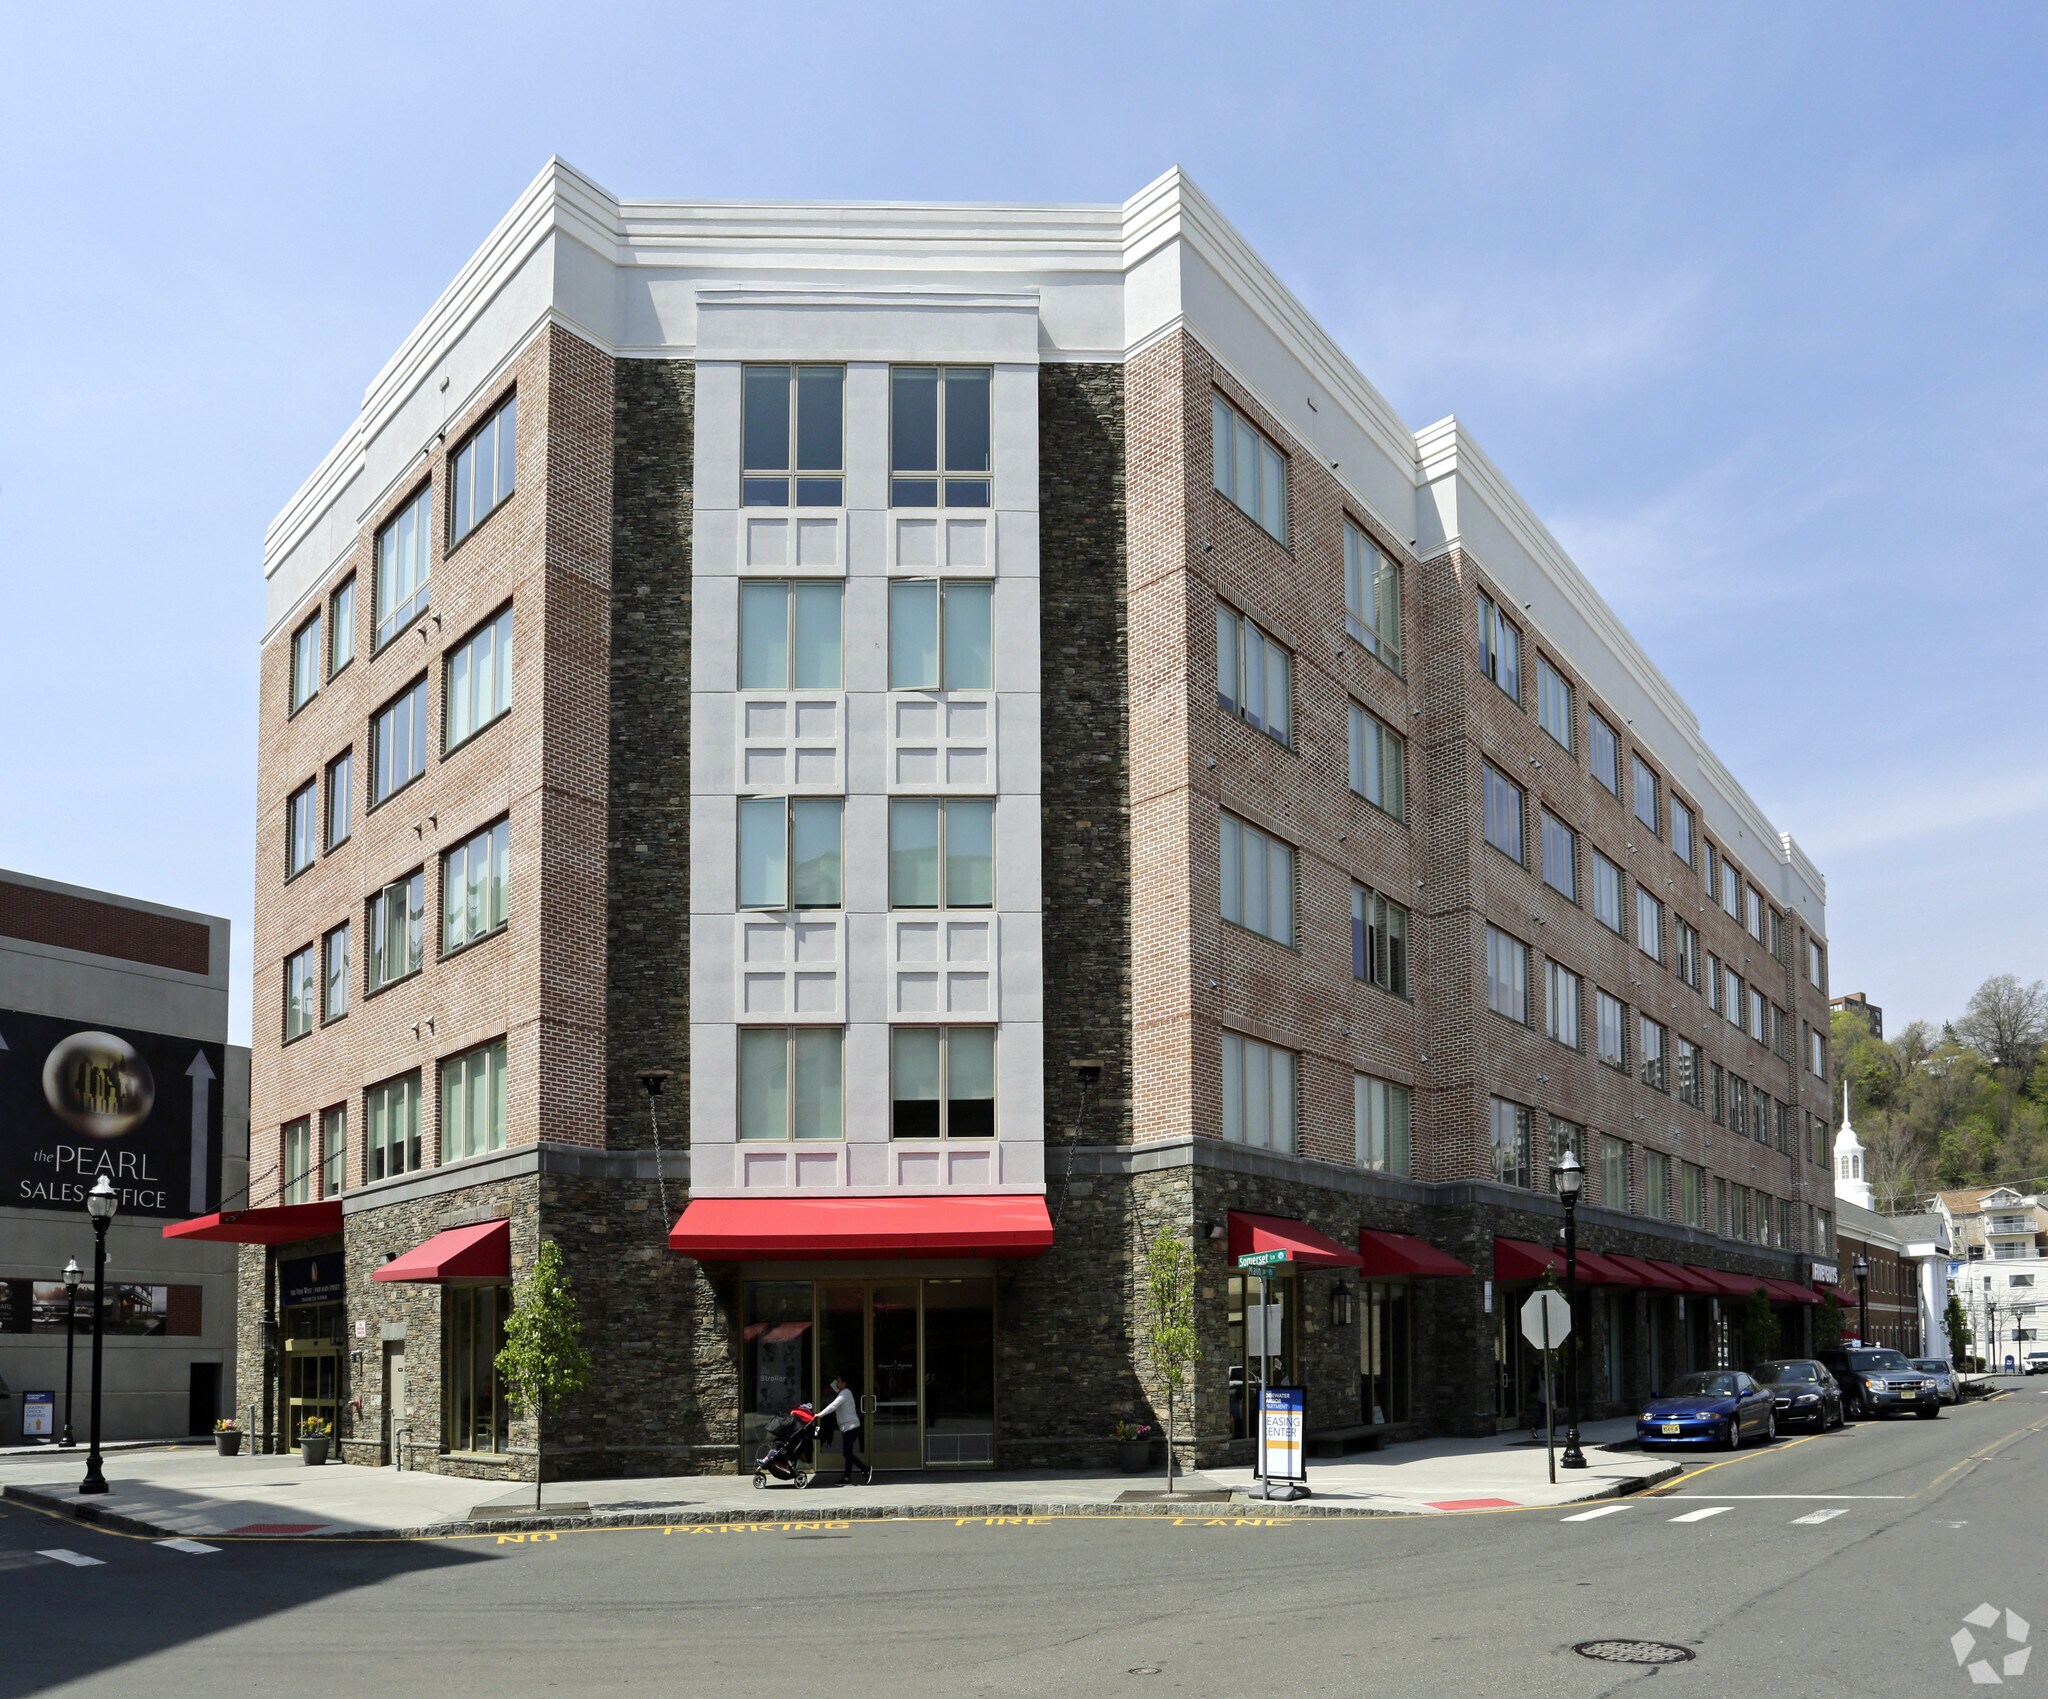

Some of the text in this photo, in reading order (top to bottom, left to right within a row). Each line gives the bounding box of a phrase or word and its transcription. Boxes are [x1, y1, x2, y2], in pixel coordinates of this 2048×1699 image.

[33, 1145, 158, 1181] the PEARL
[20, 1180, 166, 1209] SALES FICE
[1239, 1253, 1268, 1267] Somerset
[760, 1374, 787, 1382] Stroller
[1266, 1416, 1301, 1427] EASING
[1266, 1427, 1297, 1437] ENTER
[497, 1518, 1292, 1545] NO PARKING FIRE LANE
